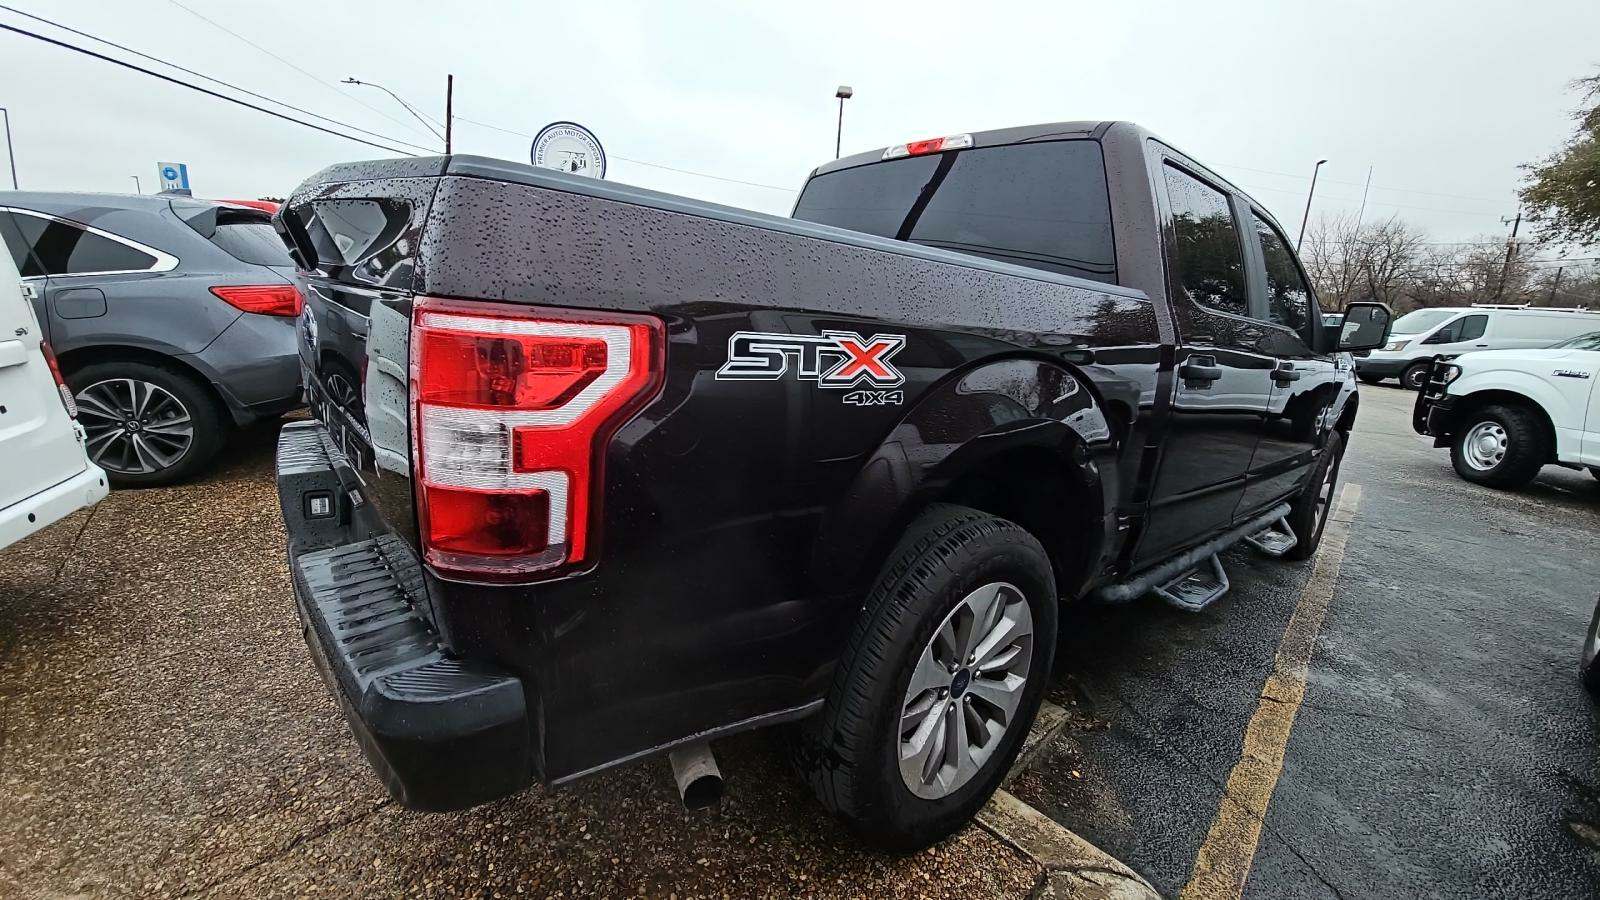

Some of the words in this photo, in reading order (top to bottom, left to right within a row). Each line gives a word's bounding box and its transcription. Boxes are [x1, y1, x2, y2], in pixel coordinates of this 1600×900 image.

[537, 138, 548, 165] PREMIER
[547, 130, 564, 141] AUTO
[564, 129, 587, 142] MOTOR
[715, 330, 906, 388] STX
